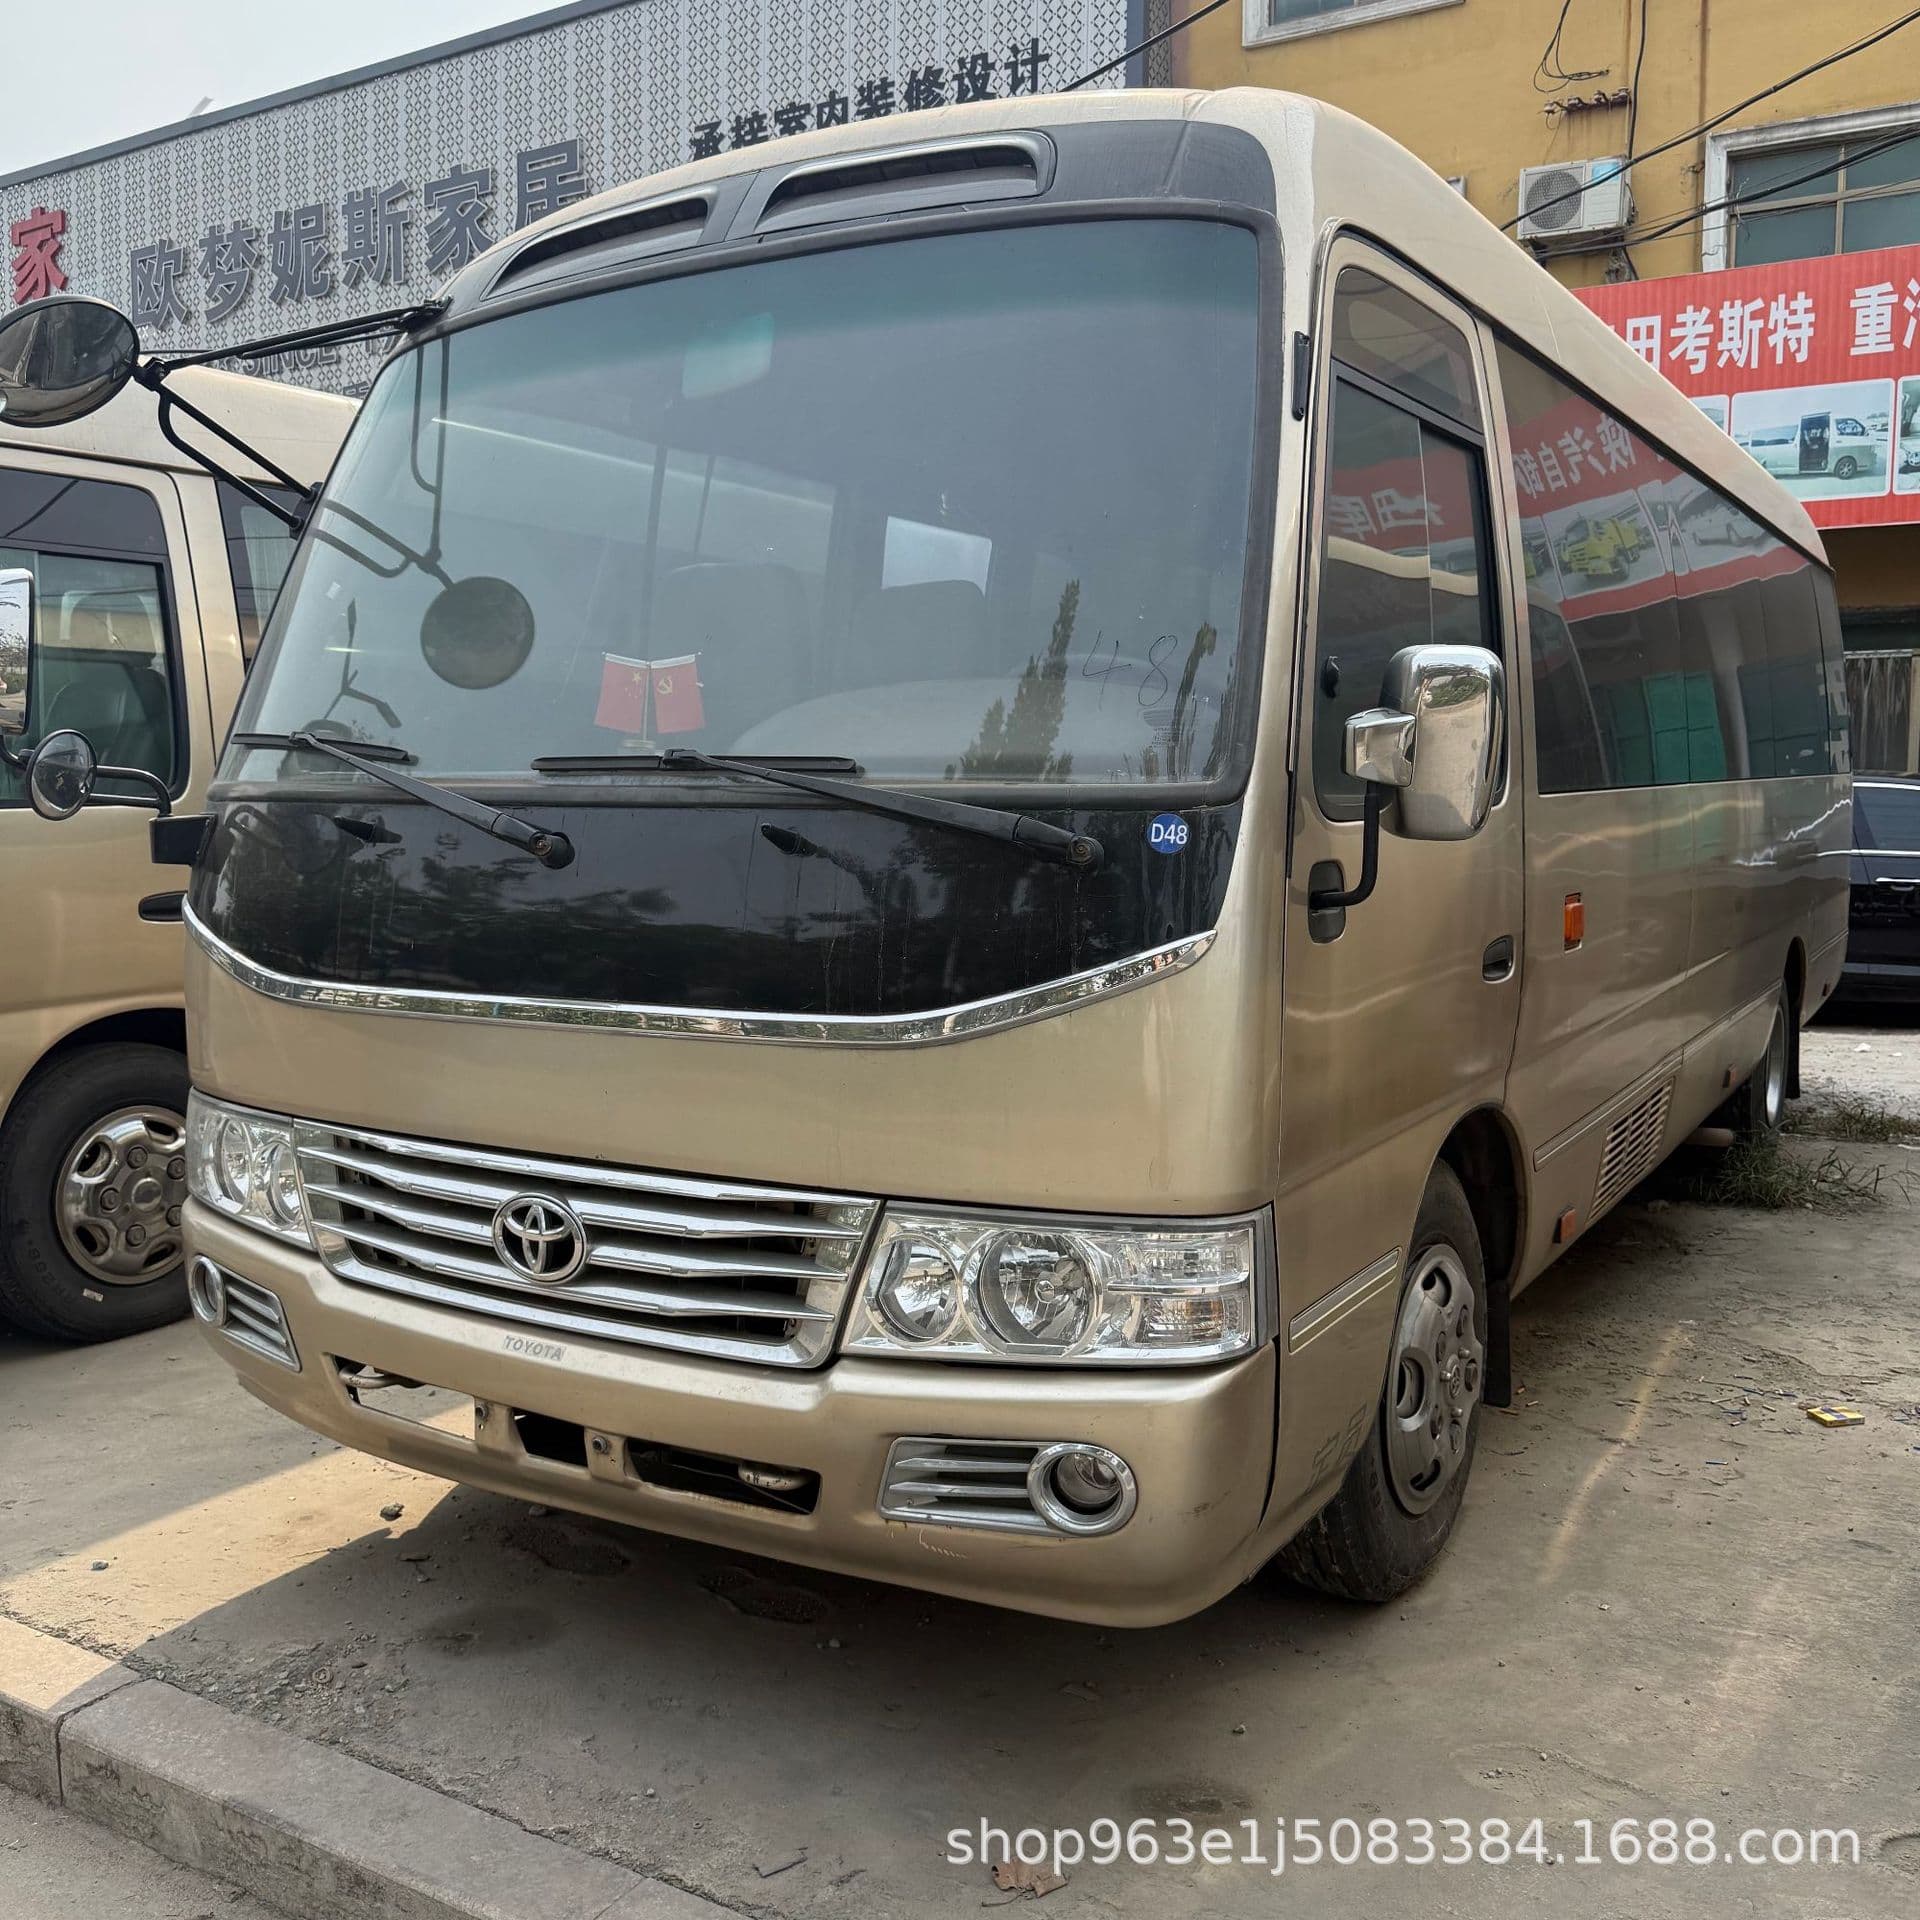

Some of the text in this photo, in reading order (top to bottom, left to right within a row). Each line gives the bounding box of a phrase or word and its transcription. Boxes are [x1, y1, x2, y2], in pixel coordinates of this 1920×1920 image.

[11, 206, 68, 304] 家
[130, 139, 587, 330] 欧梦妮斯家居
[1609, 291, 1816, 375] 田考斯特
[1150, 822, 1188, 846] D48
[503, 1335, 567, 1361] TOYOTA
